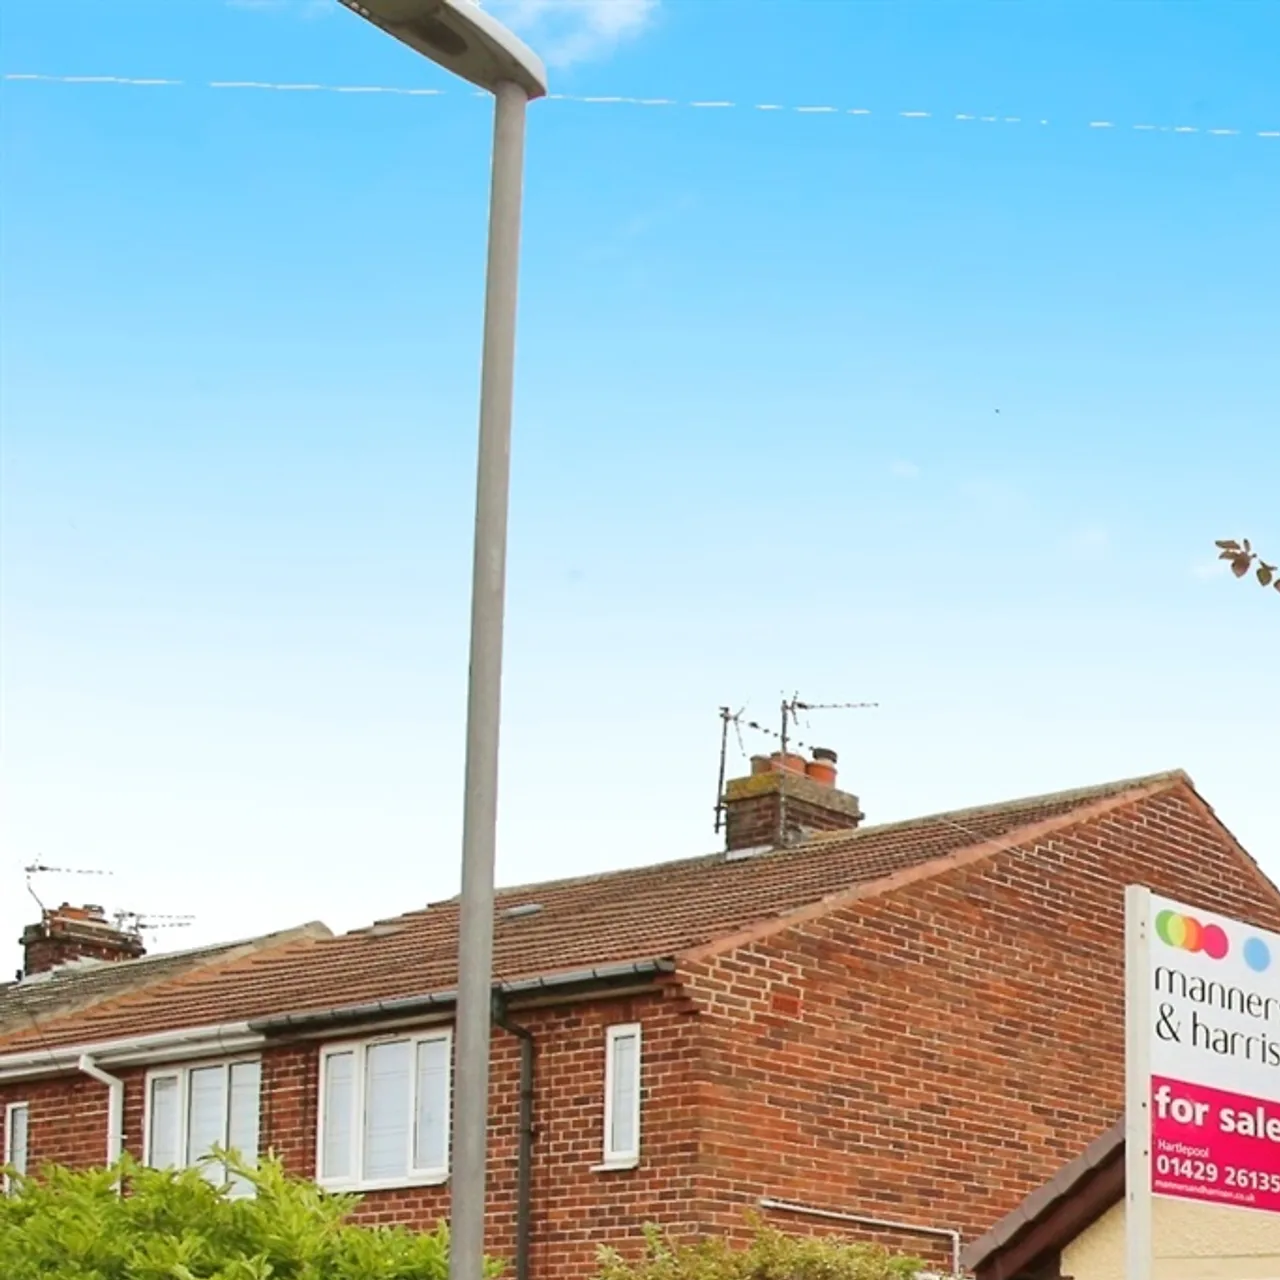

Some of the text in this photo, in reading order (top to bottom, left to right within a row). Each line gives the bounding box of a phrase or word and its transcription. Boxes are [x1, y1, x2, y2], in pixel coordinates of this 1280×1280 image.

[1155, 1002, 1181, 1043] &
[1154, 1085, 1209, 1126] for
[1157, 1139, 1210, 1158] Hartlepool
[1156, 1154, 1218, 1183] 01429
